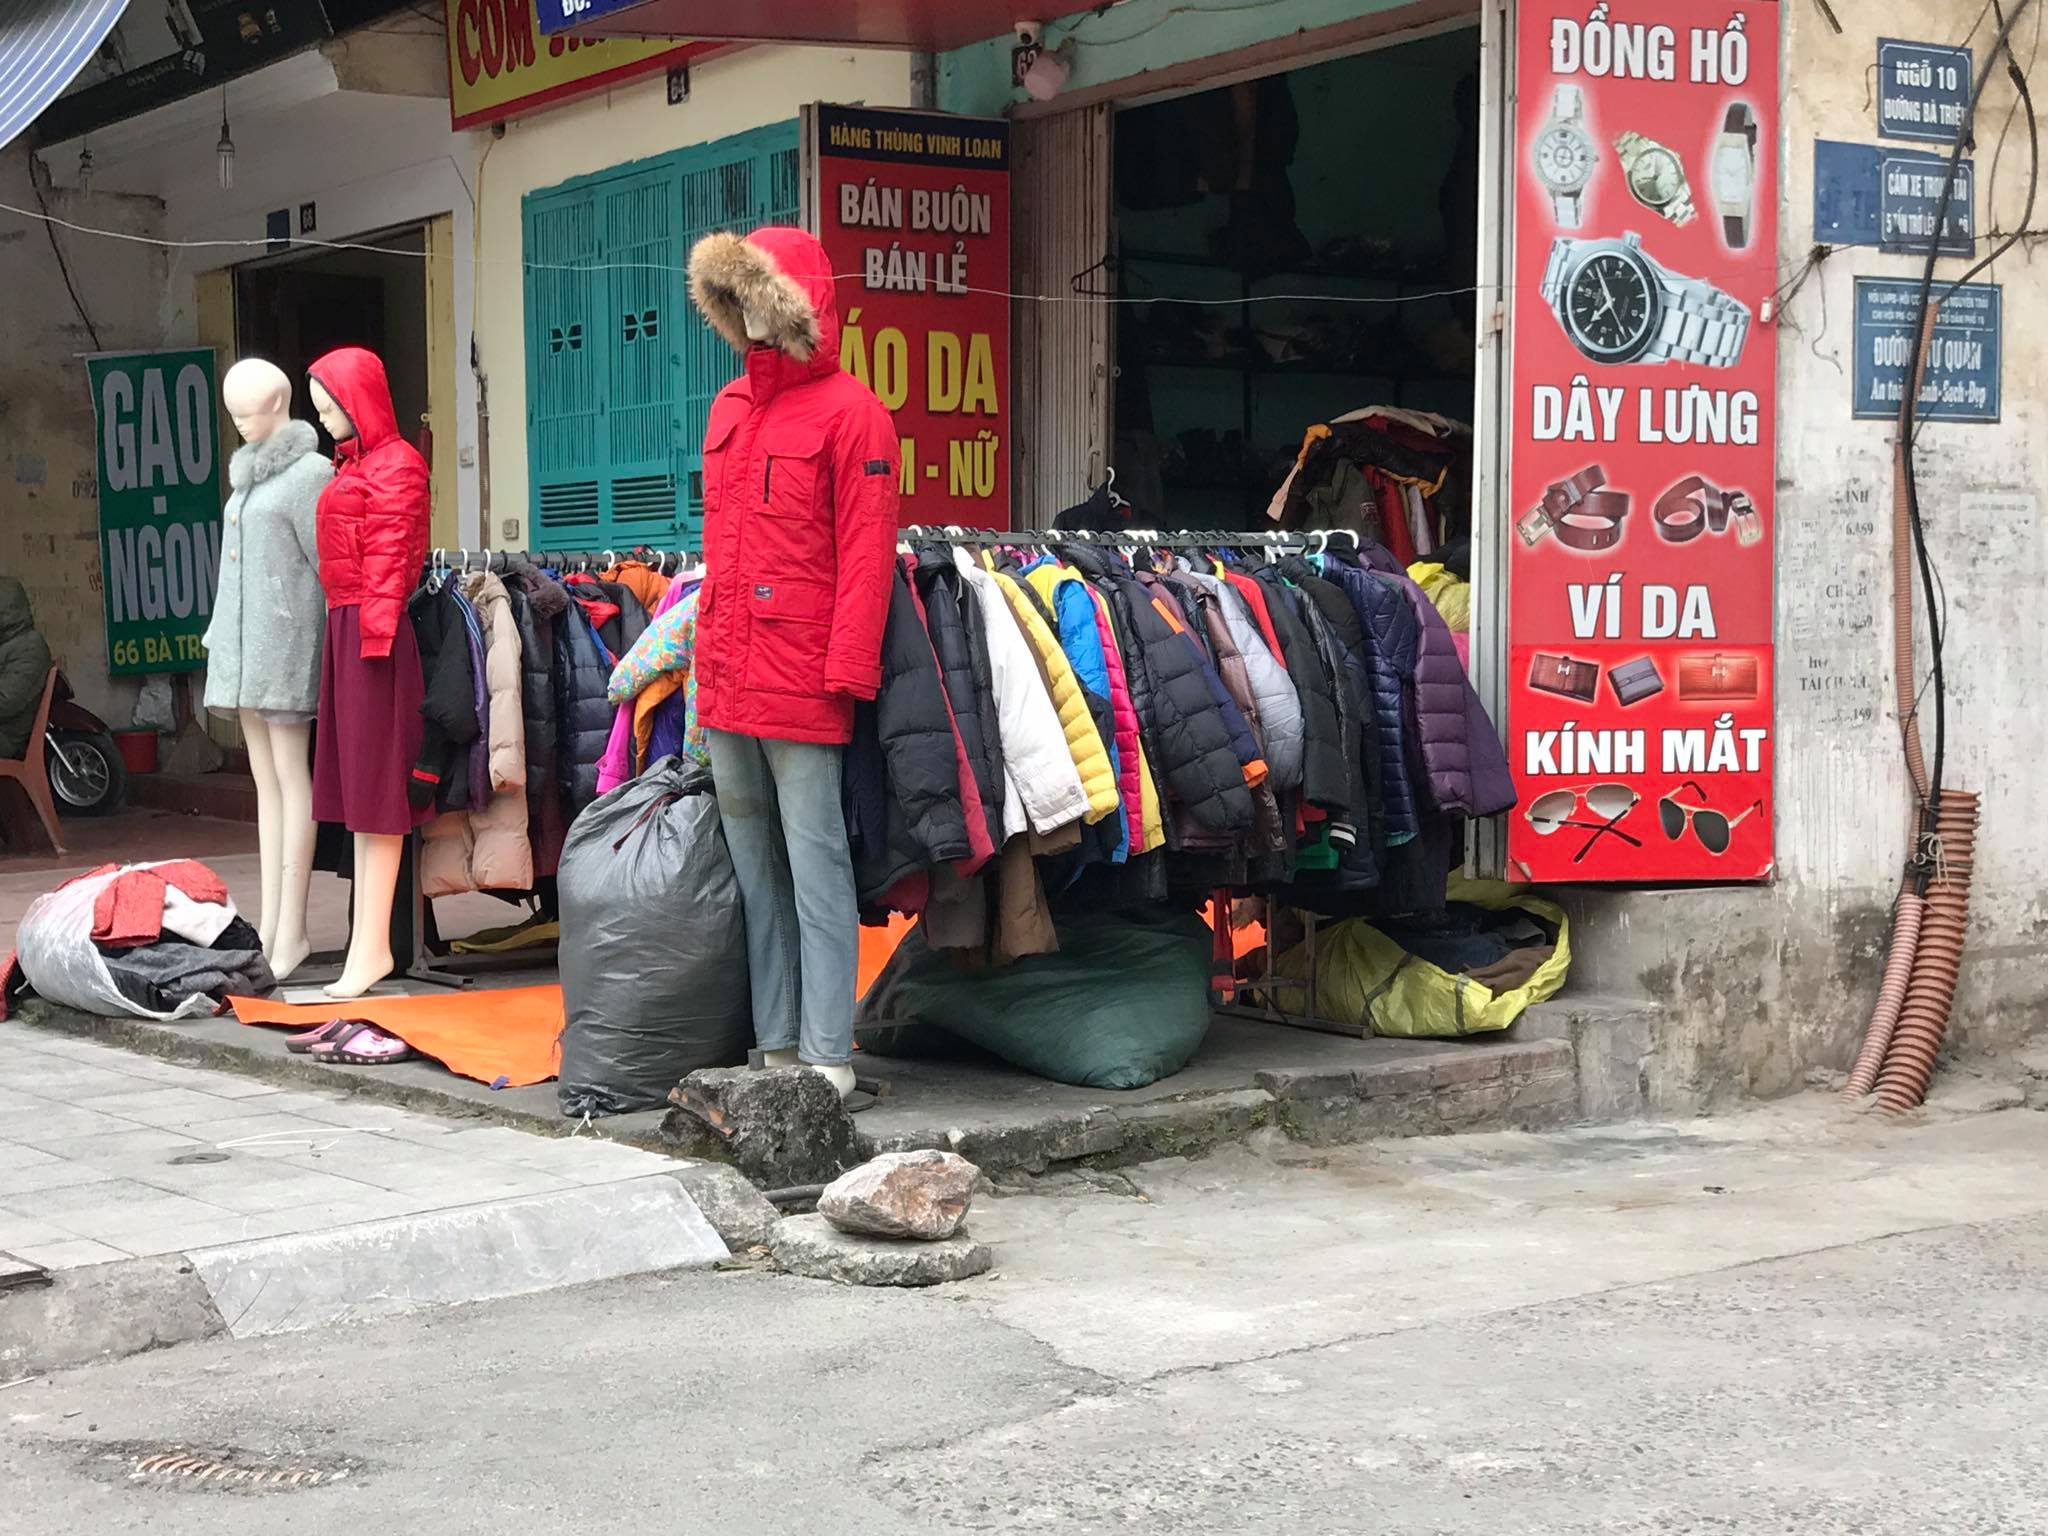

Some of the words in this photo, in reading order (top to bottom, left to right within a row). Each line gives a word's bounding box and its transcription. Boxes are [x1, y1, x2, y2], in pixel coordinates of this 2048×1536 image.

[1550, 1, 1676, 81] ĐỒNG
[1690, 12, 1748, 86] HỒ
[1937, 66, 1957, 91] 10
[830, 122, 871, 149] HÀNG
[875, 127, 923, 153] THÙNG
[927, 134, 961, 157] VINH
[964, 137, 1002, 159] LOAN
[1922, 99, 1938, 124] BÀ
[840, 176, 903, 227] BÁN
[912, 183, 991, 235] BUÔN
[1910, 175, 1922, 198] XE
[865, 241, 927, 293] BÁN
[935, 240, 969, 294] LẺ
[839, 307, 909, 411] ÁO
[928, 330, 999, 415] DA
[1874, 329, 1914, 367] ĐƯỜN
[102, 363, 212, 515] GẠO
[1532, 374, 1625, 441] DÂY
[1639, 384, 1758, 445] LƯNG
[950, 429, 999, 497] NỮ
[108, 521, 220, 623] NGON
[1567, 571, 1625, 639] VÍ
[1641, 584, 1717, 639] DA
[114, 639, 140, 666] 66
[144, 631, 173, 663] BÀ
[1525, 721, 1646, 775] KÍNH
[1661, 712, 1767, 774] MẮT
